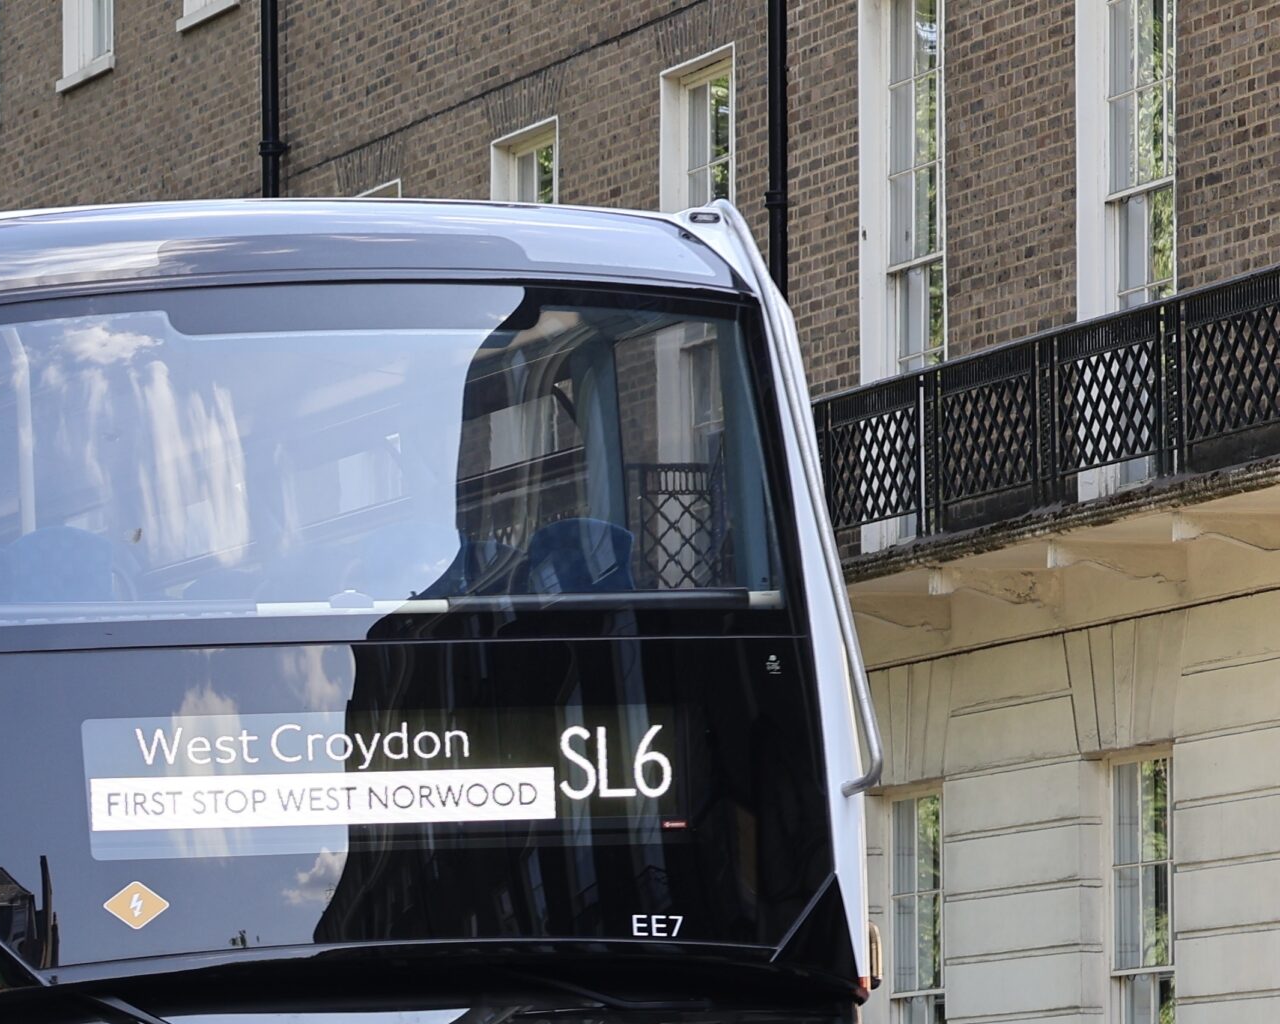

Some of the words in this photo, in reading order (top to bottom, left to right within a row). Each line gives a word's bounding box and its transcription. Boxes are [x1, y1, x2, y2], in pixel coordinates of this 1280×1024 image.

[135, 727, 260, 765] West
[270, 722, 470, 770] Croydon
[559, 724, 672, 800] SL6
[107, 790, 183, 816] FIRST
[192, 789, 267, 815] STOP
[277, 787, 357, 812] WEST
[368, 782, 538, 809] NORWOOD
[631, 914, 684, 938] EE7
